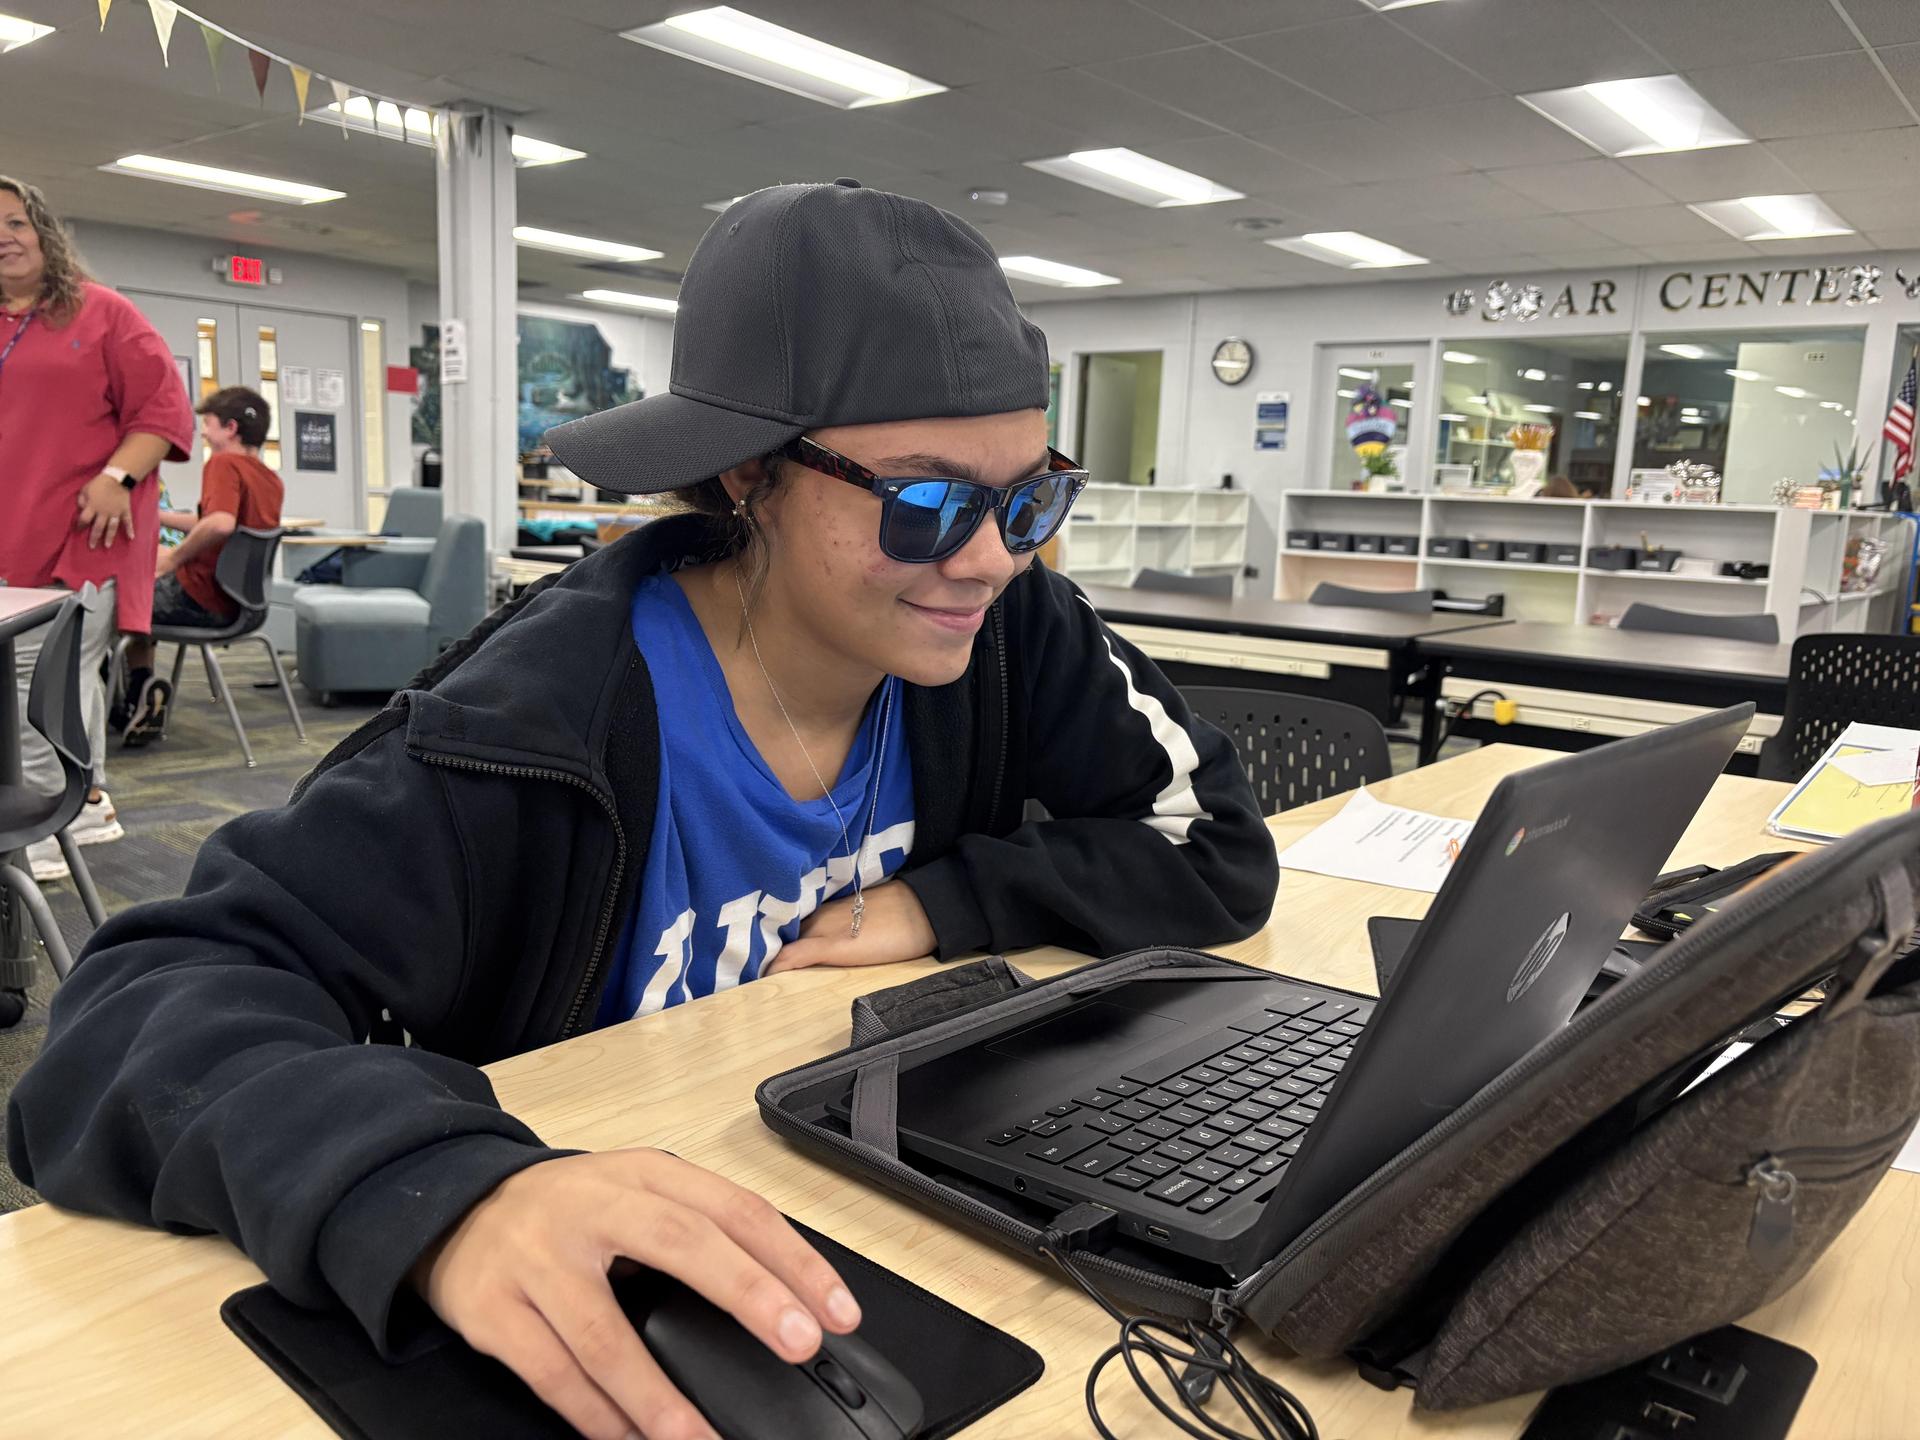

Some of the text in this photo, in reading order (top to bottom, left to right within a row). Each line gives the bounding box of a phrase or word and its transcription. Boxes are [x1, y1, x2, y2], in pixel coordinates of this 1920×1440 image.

[232, 256, 261, 284] EXIT
[1659, 264, 1883, 312] CENTER
[1163, 1179, 1191, 1194] backspace
